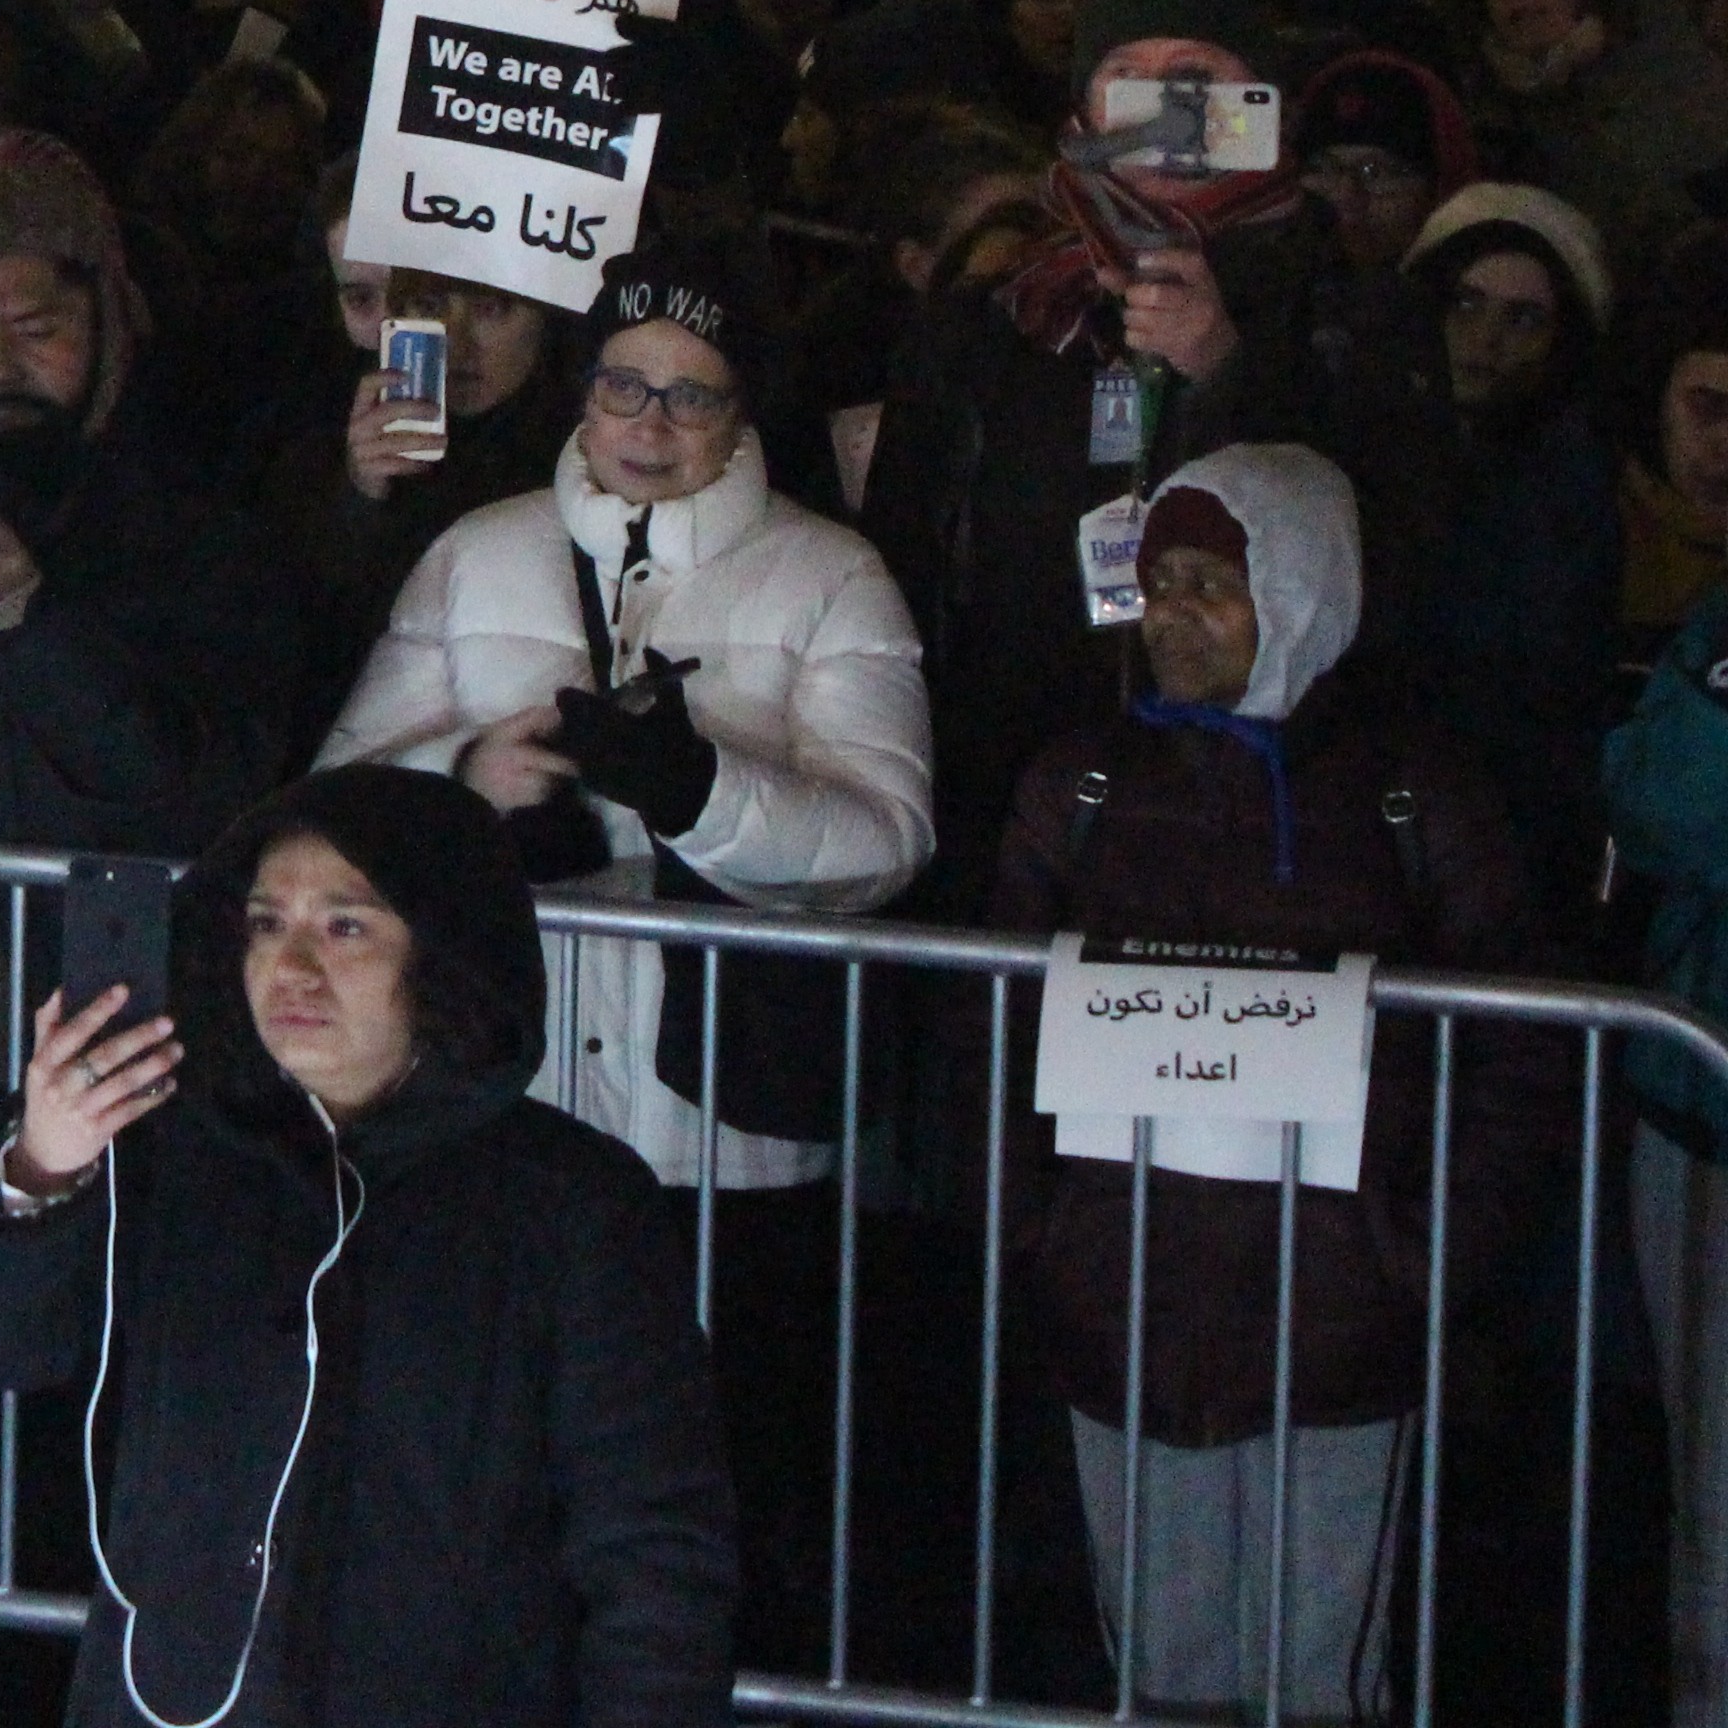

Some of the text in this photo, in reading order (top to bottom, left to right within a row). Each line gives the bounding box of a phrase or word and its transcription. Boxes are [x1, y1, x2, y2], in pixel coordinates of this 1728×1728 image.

[428, 34, 489, 76] We
[497, 56, 563, 91] are
[430, 83, 609, 152] Together
[401, 170, 607, 262] كلنا معا
[618, 282, 725, 343] NO WAR
[1090, 537, 1143, 564] Ber
[1174, 980, 1213, 1020] أن
